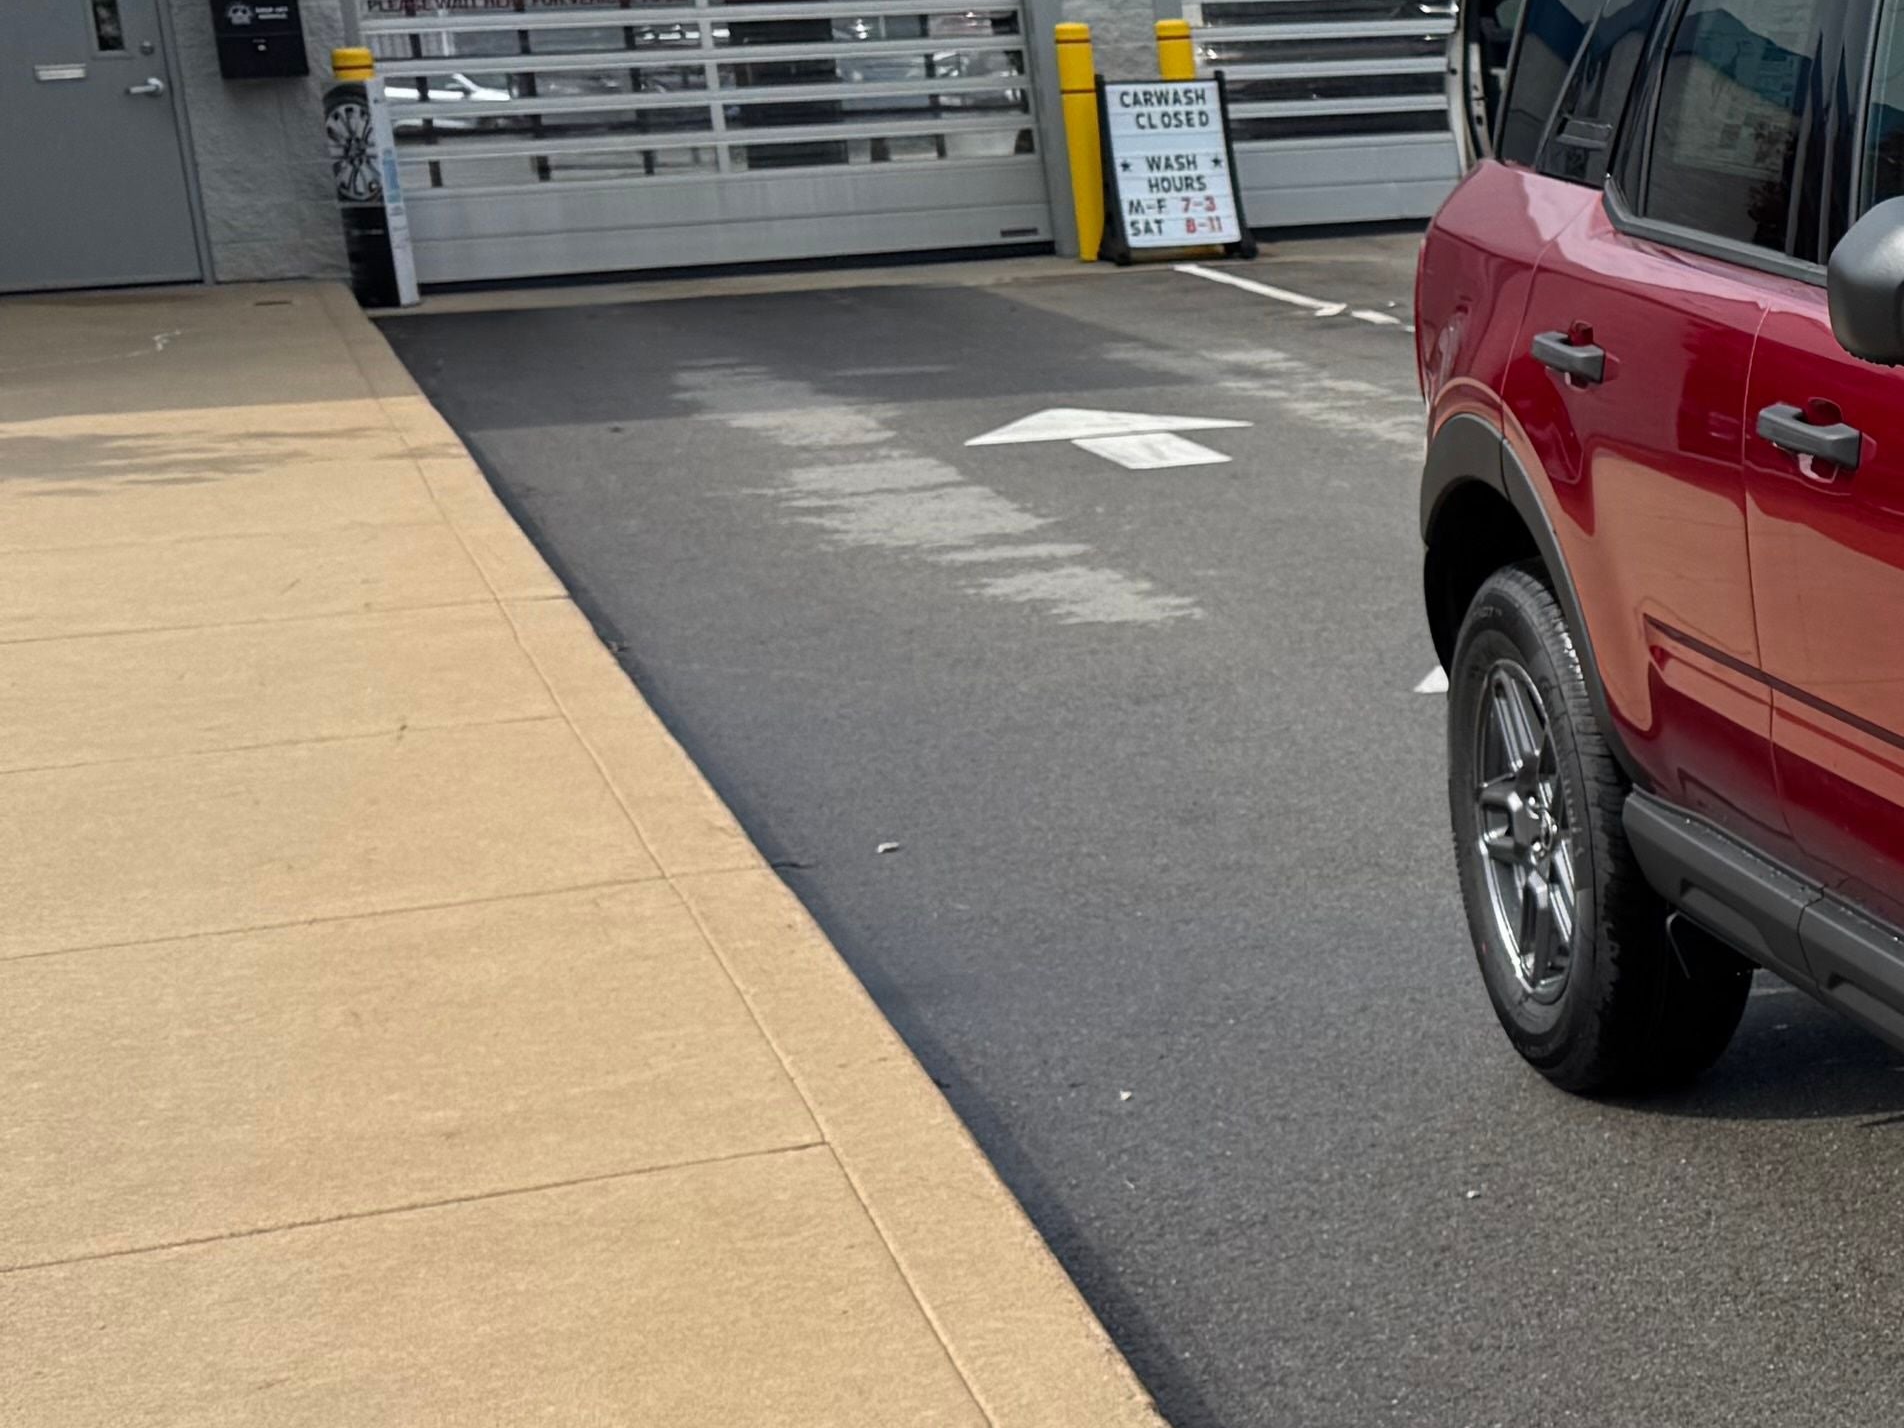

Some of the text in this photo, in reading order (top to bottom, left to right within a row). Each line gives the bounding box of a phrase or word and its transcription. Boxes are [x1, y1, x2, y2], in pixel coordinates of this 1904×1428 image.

[1119, 88, 1206, 108] CARWASH
[1136, 111, 1209, 130] CLOSED
[1145, 154, 1198, 172] WASH
[1147, 175, 1207, 194] HOURS
[1128, 195, 1217, 215] M-F 7-3
[1130, 219, 1164, 237] SAT
